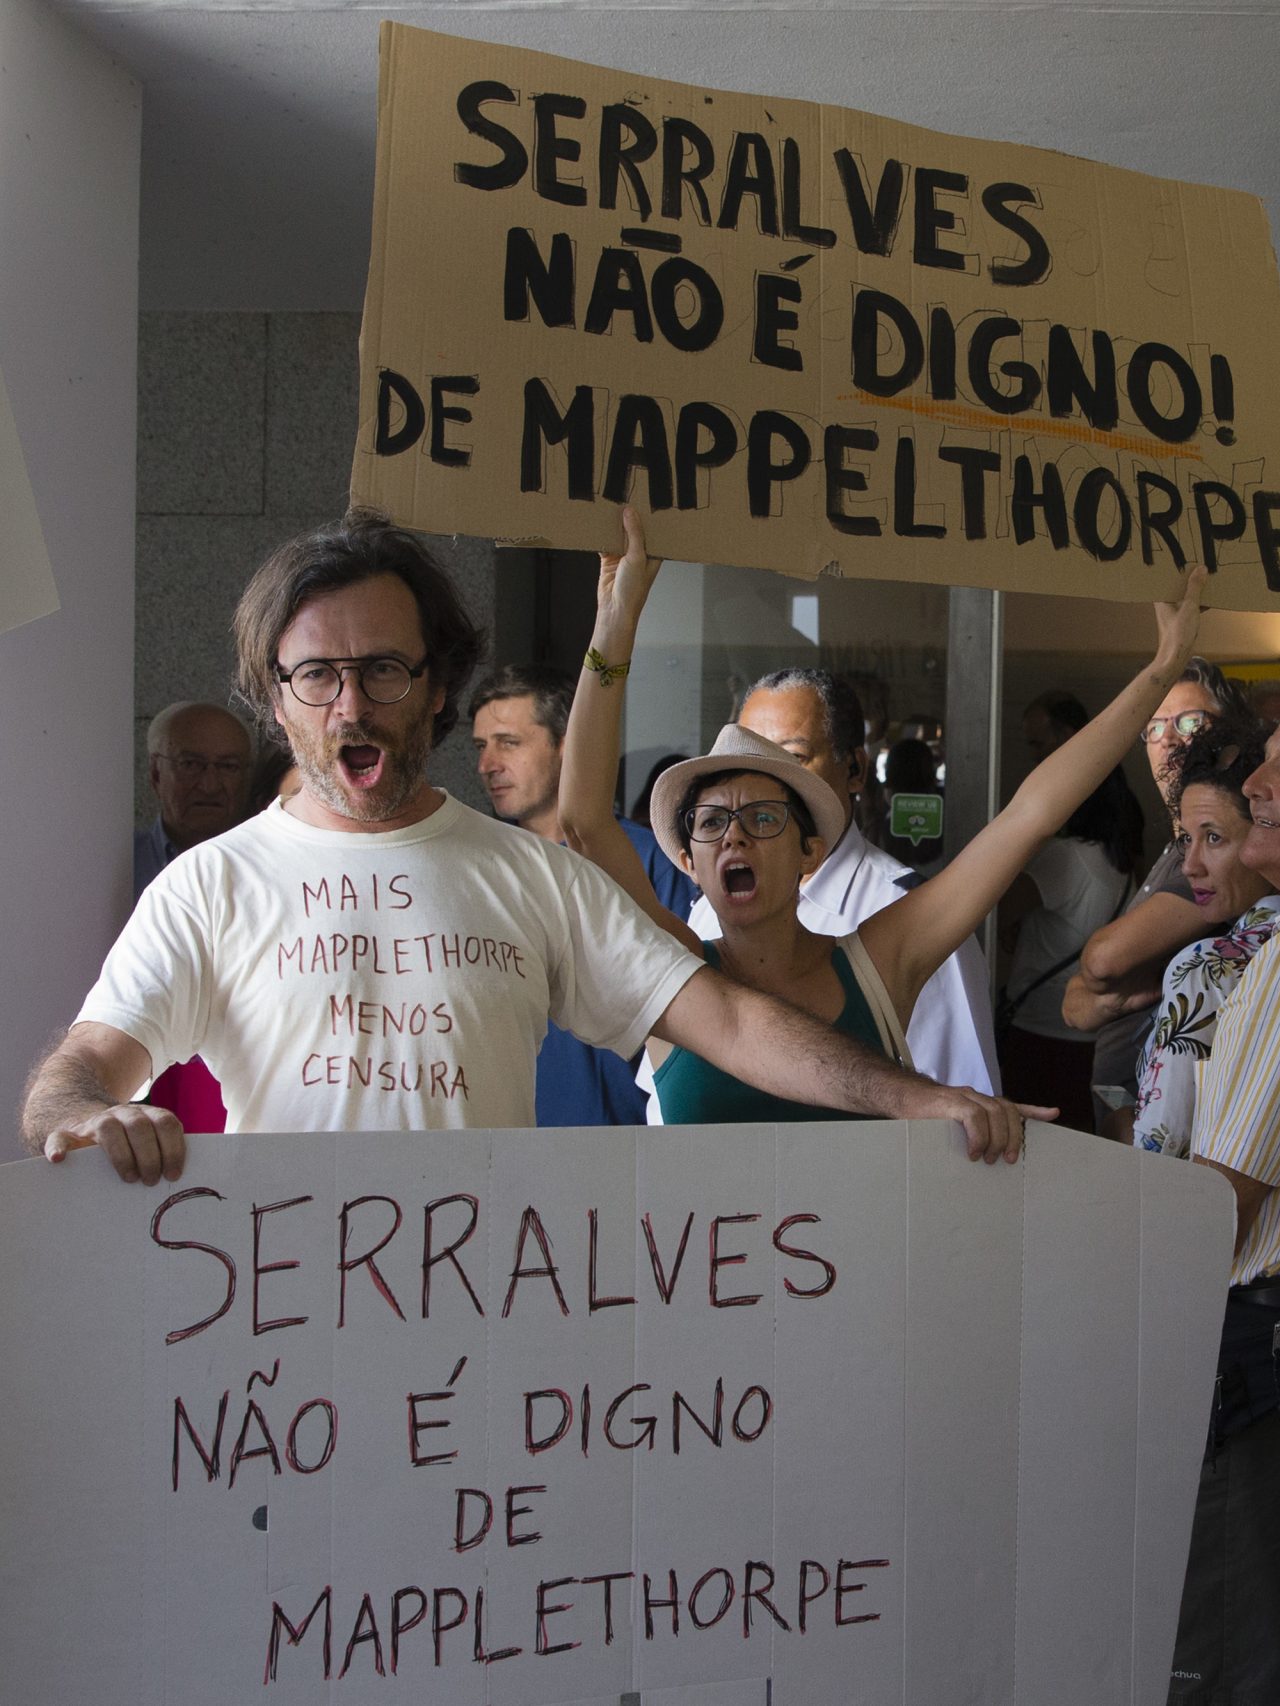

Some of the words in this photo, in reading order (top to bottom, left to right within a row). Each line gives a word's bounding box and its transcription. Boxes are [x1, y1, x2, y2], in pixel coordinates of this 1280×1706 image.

[453, 80, 1051, 287] SERRALVES
[503, 226, 725, 353] NÃO
[753, 253, 815, 372] É
[851, 289, 1238, 447] DIGNO!
[375, 367, 482, 468] DE
[302, 873, 413, 918] MAIS
[277, 932, 527, 980] MAPPLETHORPE
[329, 993, 453, 1038] MENOS
[302, 1053, 470, 1101] CENSURA
[150, 1186, 837, 1347] SERRALVES
[171, 1358, 338, 1493] NÃO
[406, 1355, 468, 1468] É
[522, 1376, 772, 1459] DIGNO
[450, 1484, 547, 1554] DE
[263, 1558, 890, 1685] MAPPLETHORPE
